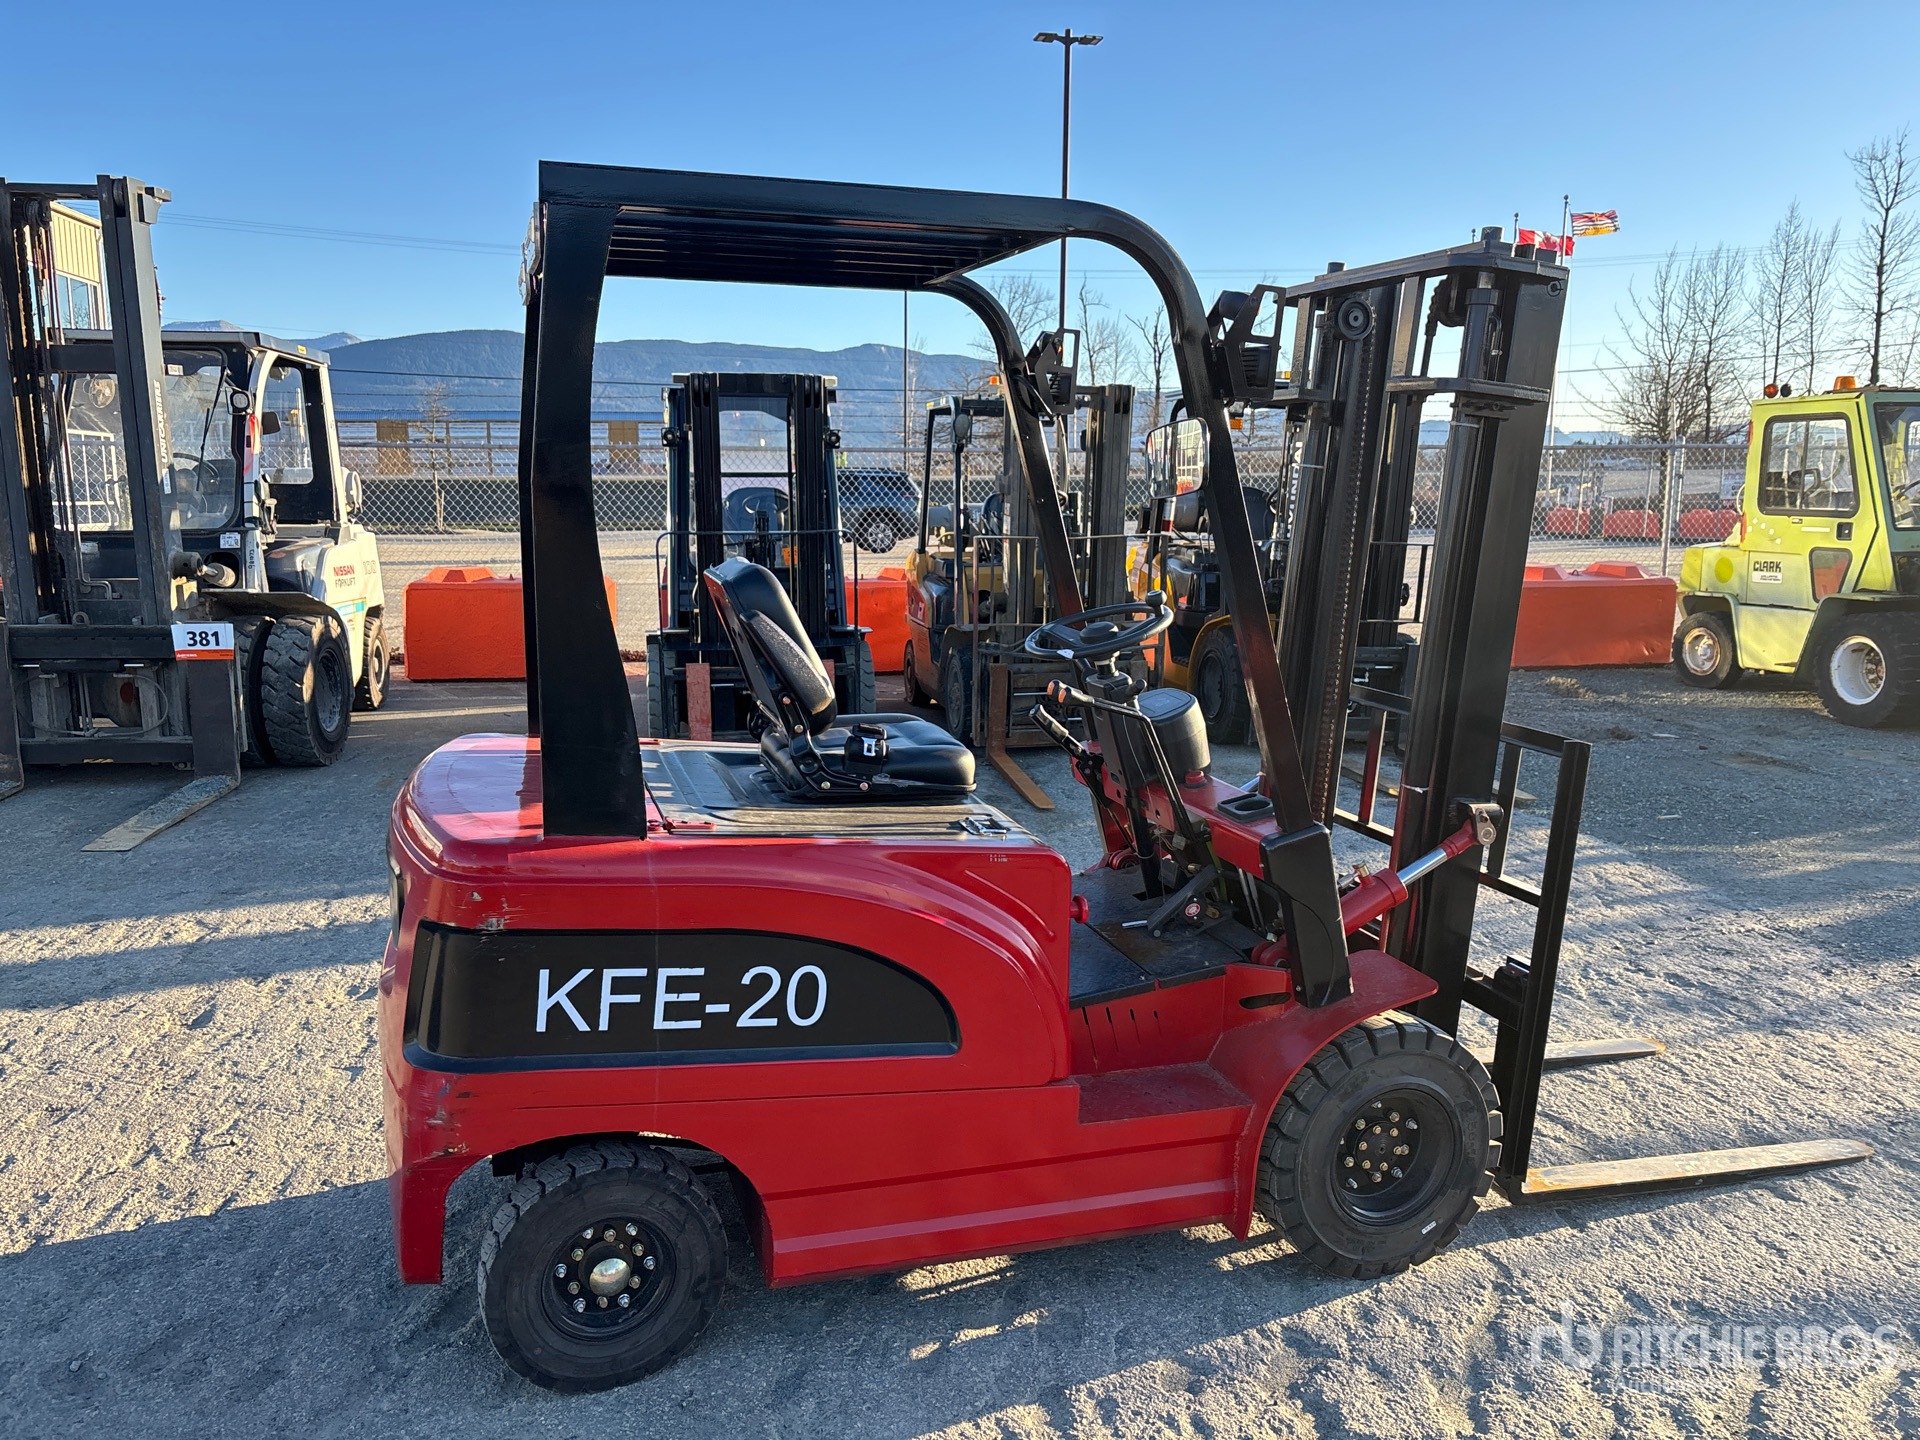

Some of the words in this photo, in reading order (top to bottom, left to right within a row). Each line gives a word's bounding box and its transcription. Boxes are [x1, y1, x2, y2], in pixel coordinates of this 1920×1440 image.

[154, 379, 168, 463] UNICARRIERS
[333, 565, 355, 577] NISSAN
[1753, 560, 1782, 573] CLARK
[334, 577, 356, 588] FORKLIFT
[186, 630, 221, 647] 381
[535, 964, 828, 1032] KFE-20
